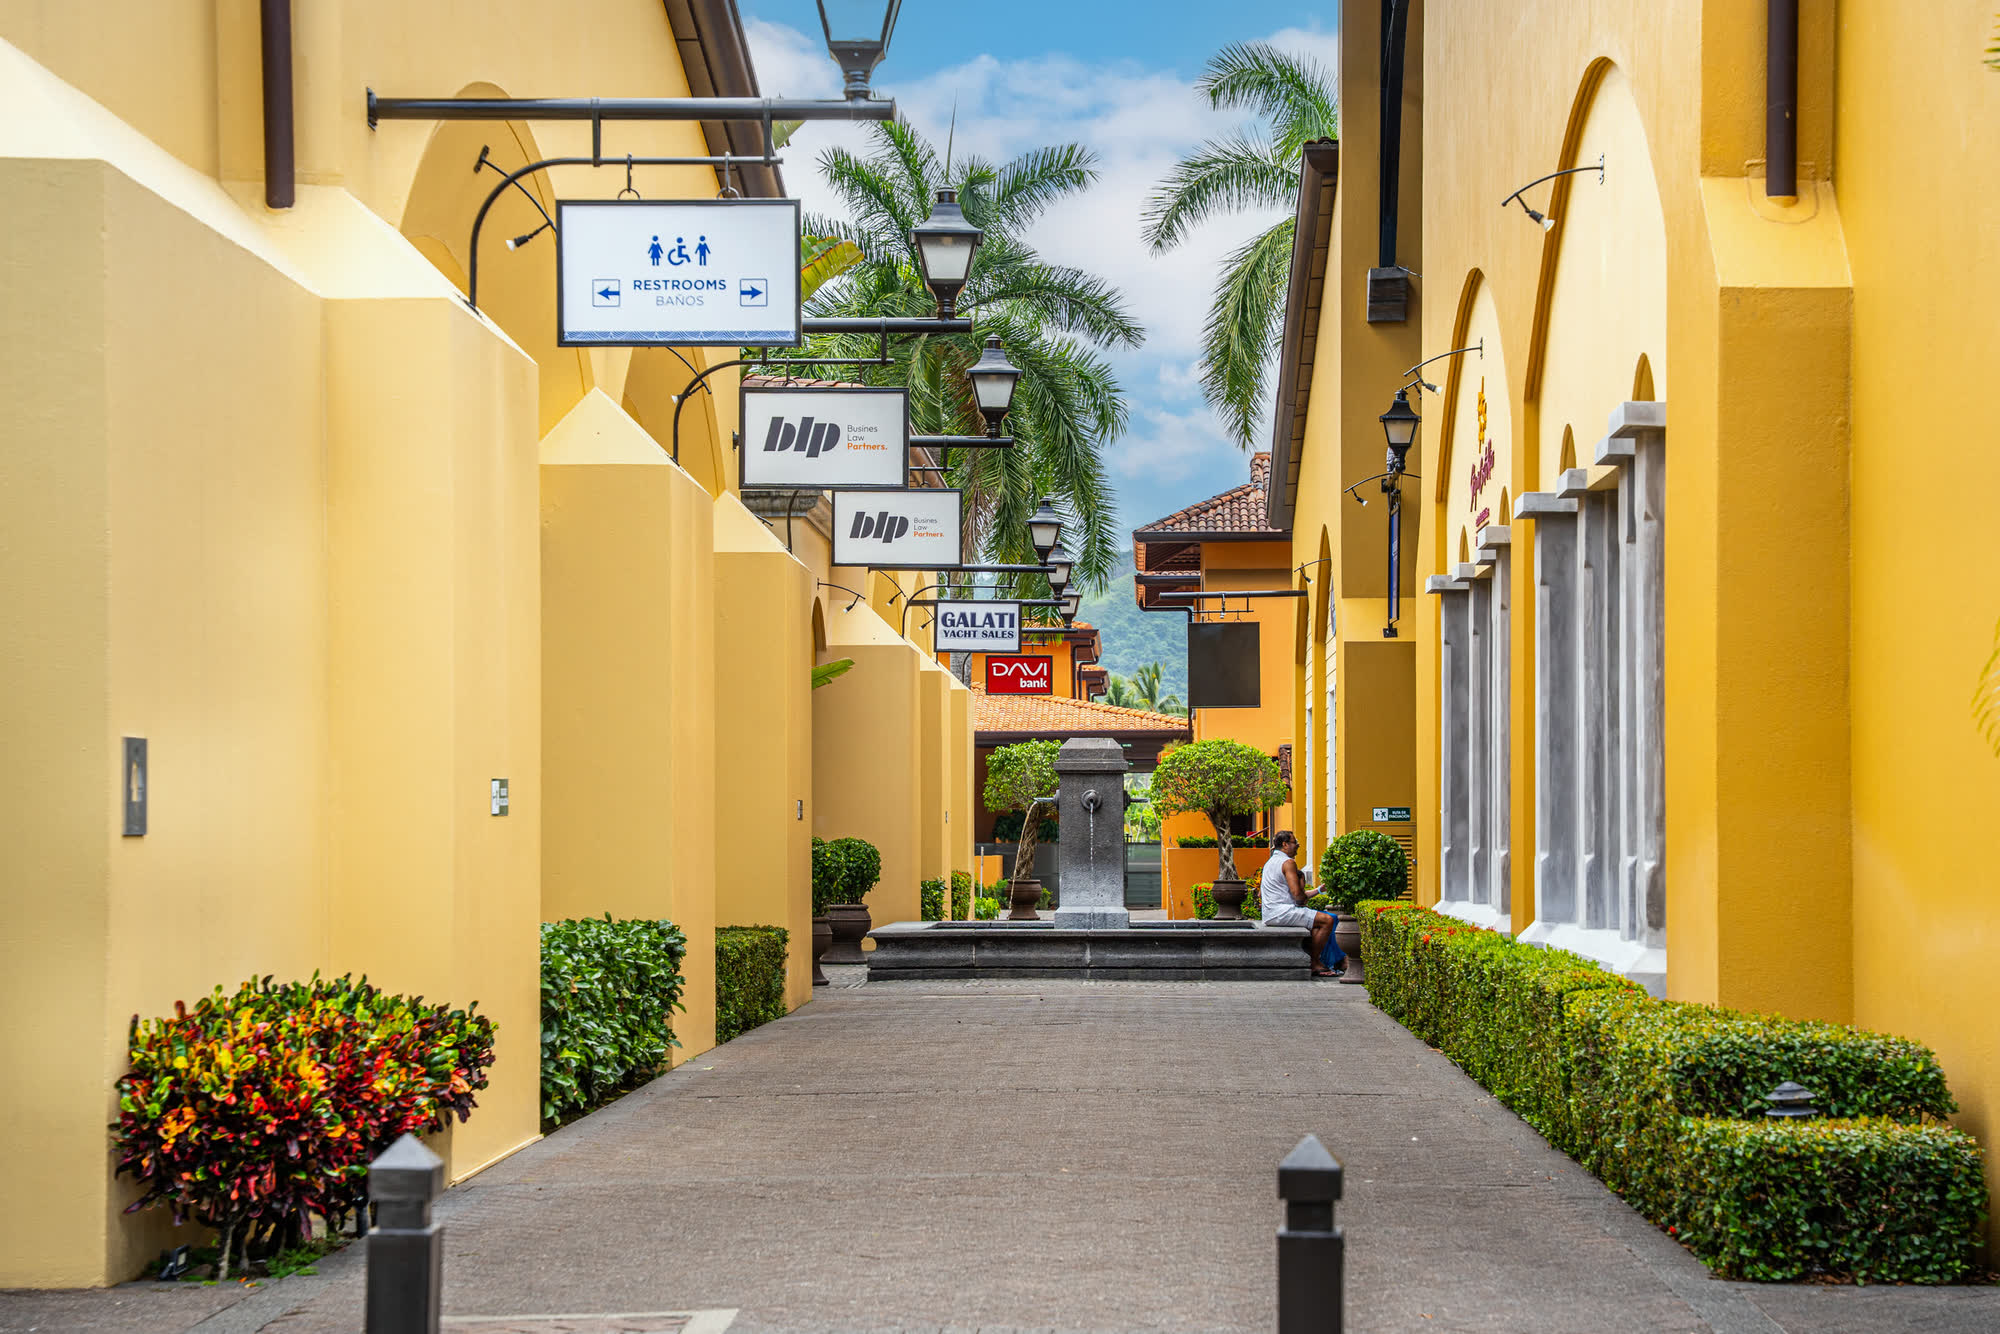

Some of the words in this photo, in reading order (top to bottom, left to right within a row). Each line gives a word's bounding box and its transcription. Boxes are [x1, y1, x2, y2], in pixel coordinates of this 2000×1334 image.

[633, 279, 726, 290] RESTROOMS
[656, 293, 704, 306] BAÑOS
[847, 424, 878, 433] Busines
[763, 416, 841, 458] blp
[847, 442, 888, 450] Partners.
[849, 511, 909, 543] blp
[941, 612, 1015, 628] GALATI
[943, 630, 977, 638] YACHT
[981, 630, 1014, 639] SALES
[992, 662, 1047, 676] DAVI
[1020, 678, 1047, 688] bank
